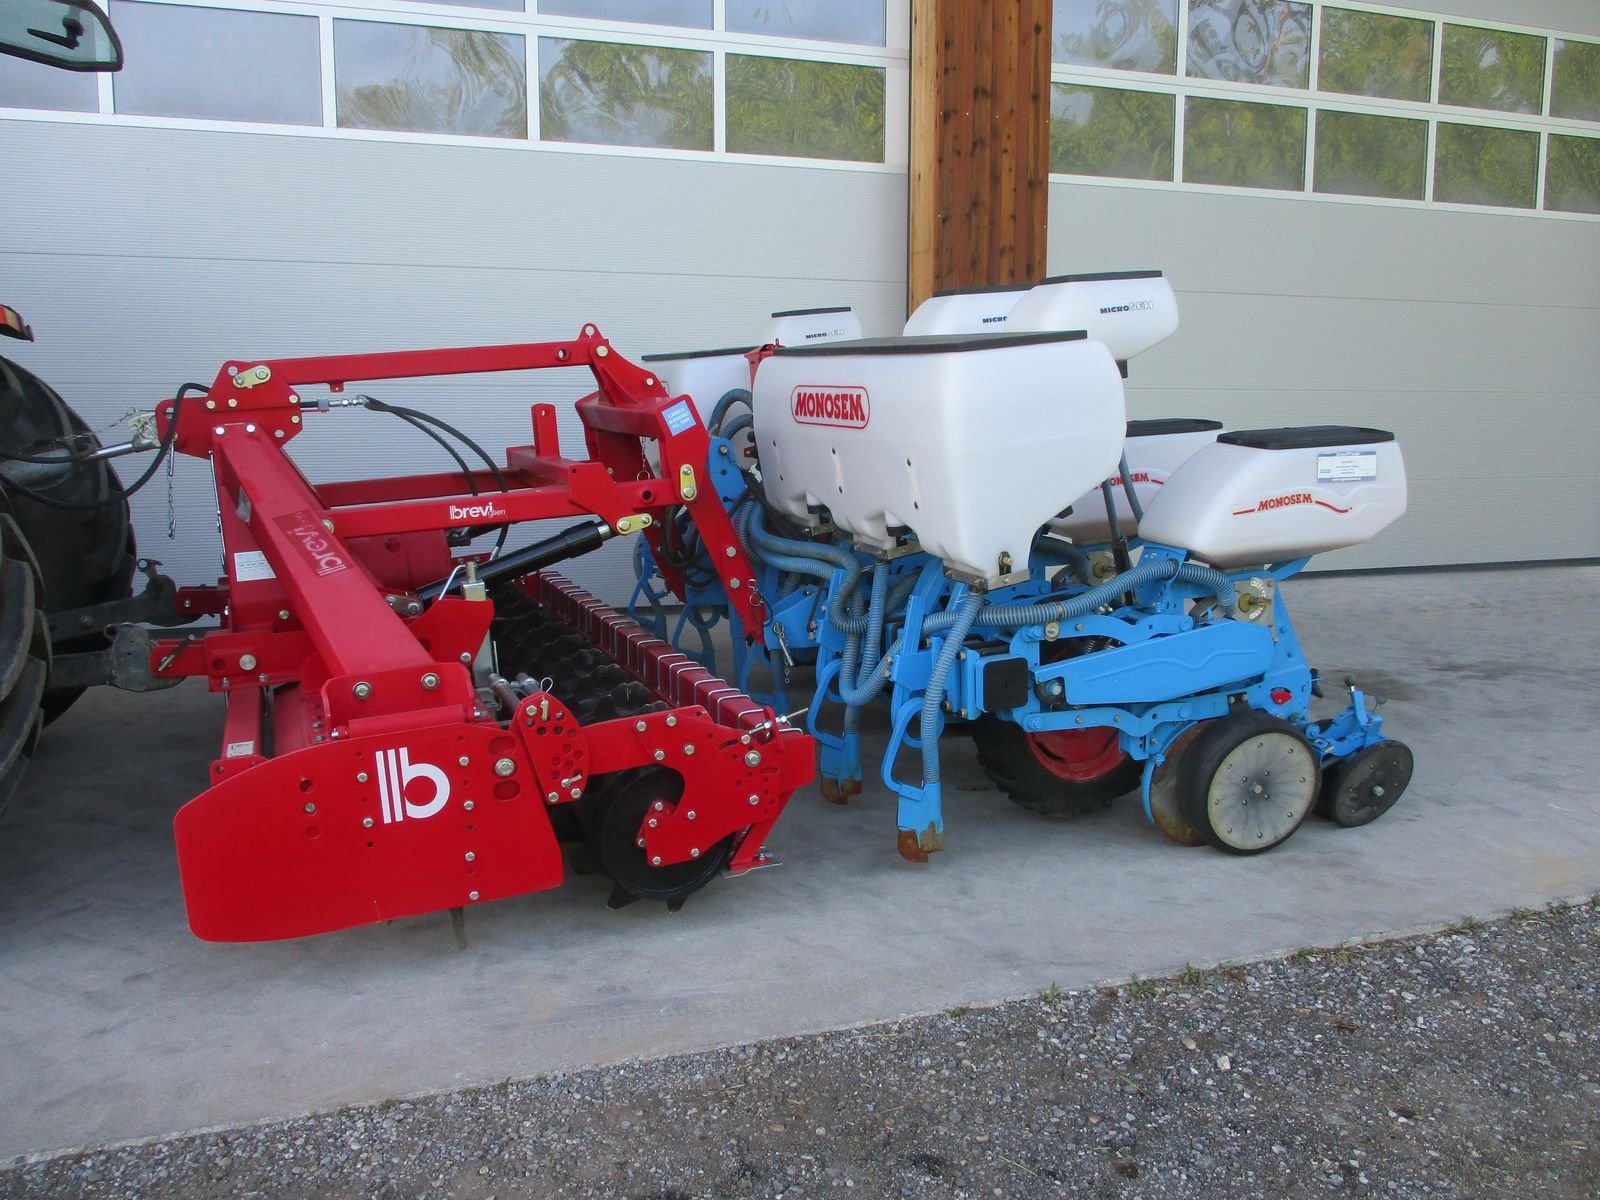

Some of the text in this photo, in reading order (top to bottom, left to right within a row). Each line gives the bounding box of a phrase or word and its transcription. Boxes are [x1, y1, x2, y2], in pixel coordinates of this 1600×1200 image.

[795, 392, 865, 421] MONOSEM
[1101, 473, 1149, 488] ONSEM
[450, 502, 493, 520] brevi
[1258, 493, 1313, 511] MONOSEM
